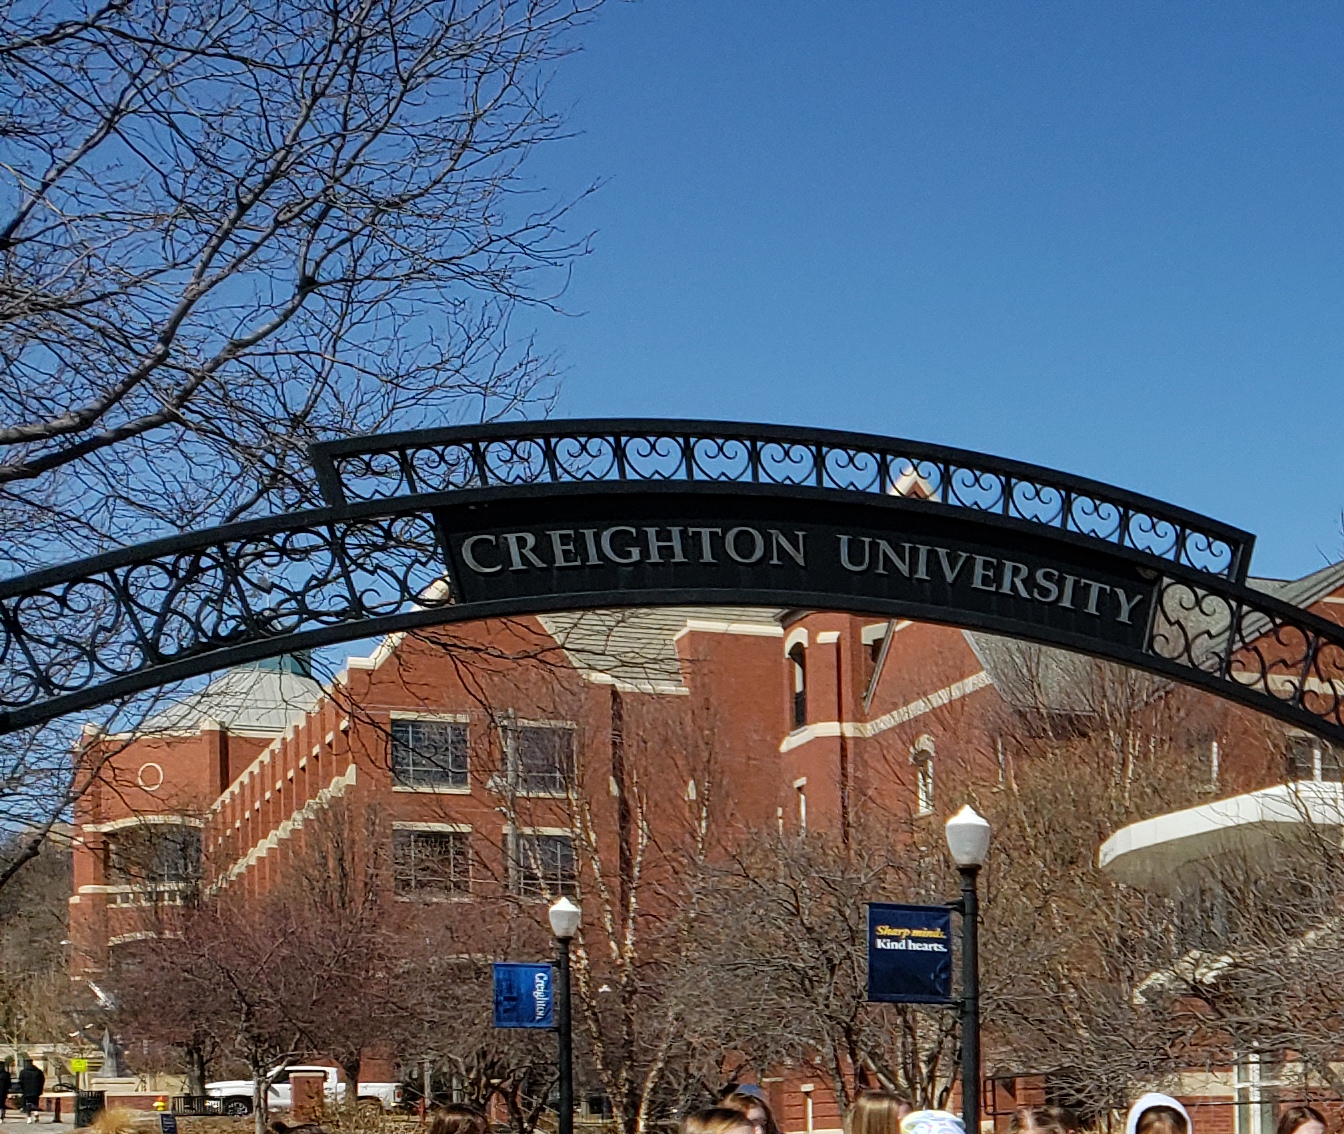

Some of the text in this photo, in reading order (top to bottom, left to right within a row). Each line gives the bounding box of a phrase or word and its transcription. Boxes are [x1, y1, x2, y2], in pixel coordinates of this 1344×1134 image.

[460, 523, 1143, 626] CREIGHTON UNIVERSITY
[876, 925, 911, 938] Sharp
[876, 938, 948, 952] Kind hearts.
